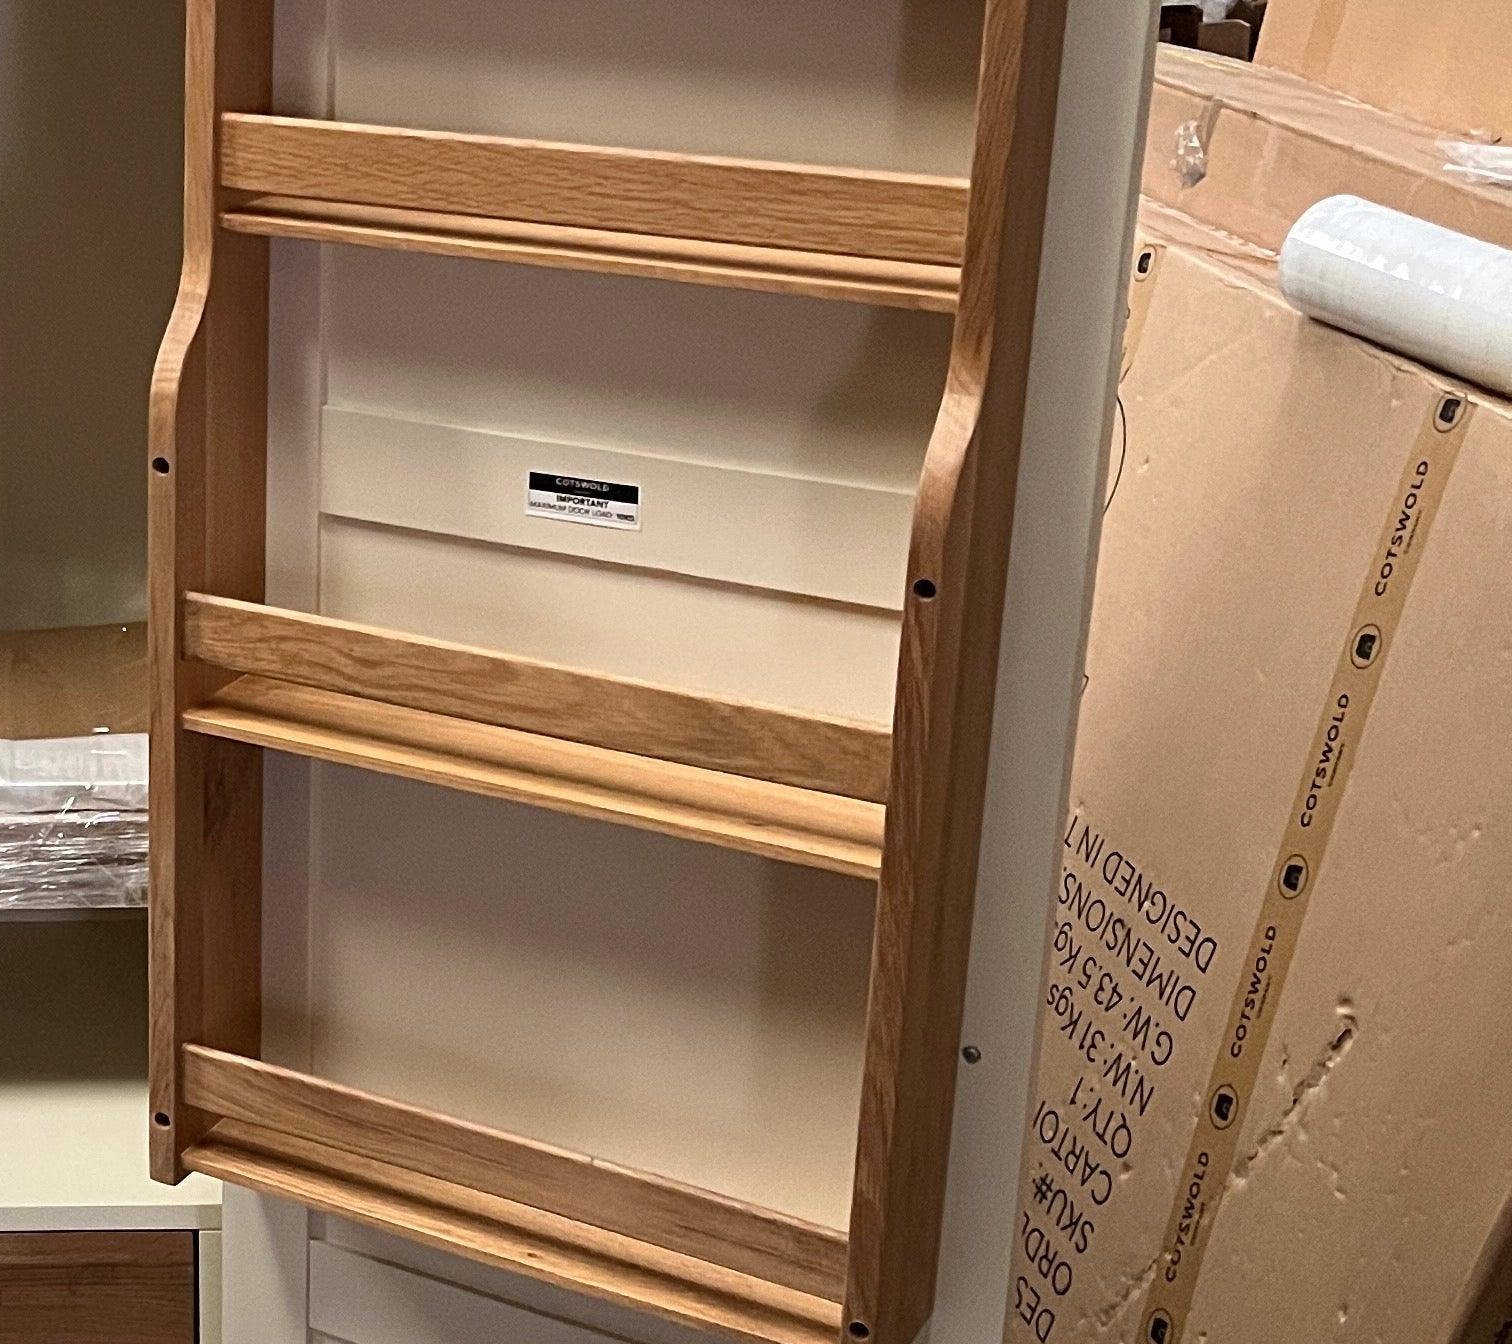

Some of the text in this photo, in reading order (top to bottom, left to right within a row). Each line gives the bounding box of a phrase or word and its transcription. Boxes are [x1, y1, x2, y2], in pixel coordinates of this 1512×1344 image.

[555, 477, 610, 493] COTSWOLD
[556, 494, 609, 509] IMPORTANT
[591, 509, 613, 519] LOAD
[1375, 460, 1429, 597] COTSWOLD
[1300, 693, 1349, 828] COTSWOLD
[1076, 825, 1106, 869] IN
[1102, 851, 1218, 974] DESIGNED
[1046, 984, 1155, 1117] N.W: 31 Kgs
[1054, 921, 1174, 1067] G.W: 43.5 Kg
[1230, 925, 1277, 1058] COTSWOLD
[1069, 1076, 1132, 1158] QTY: 1
[1164, 1151, 1210, 1283] COTSWOLD
